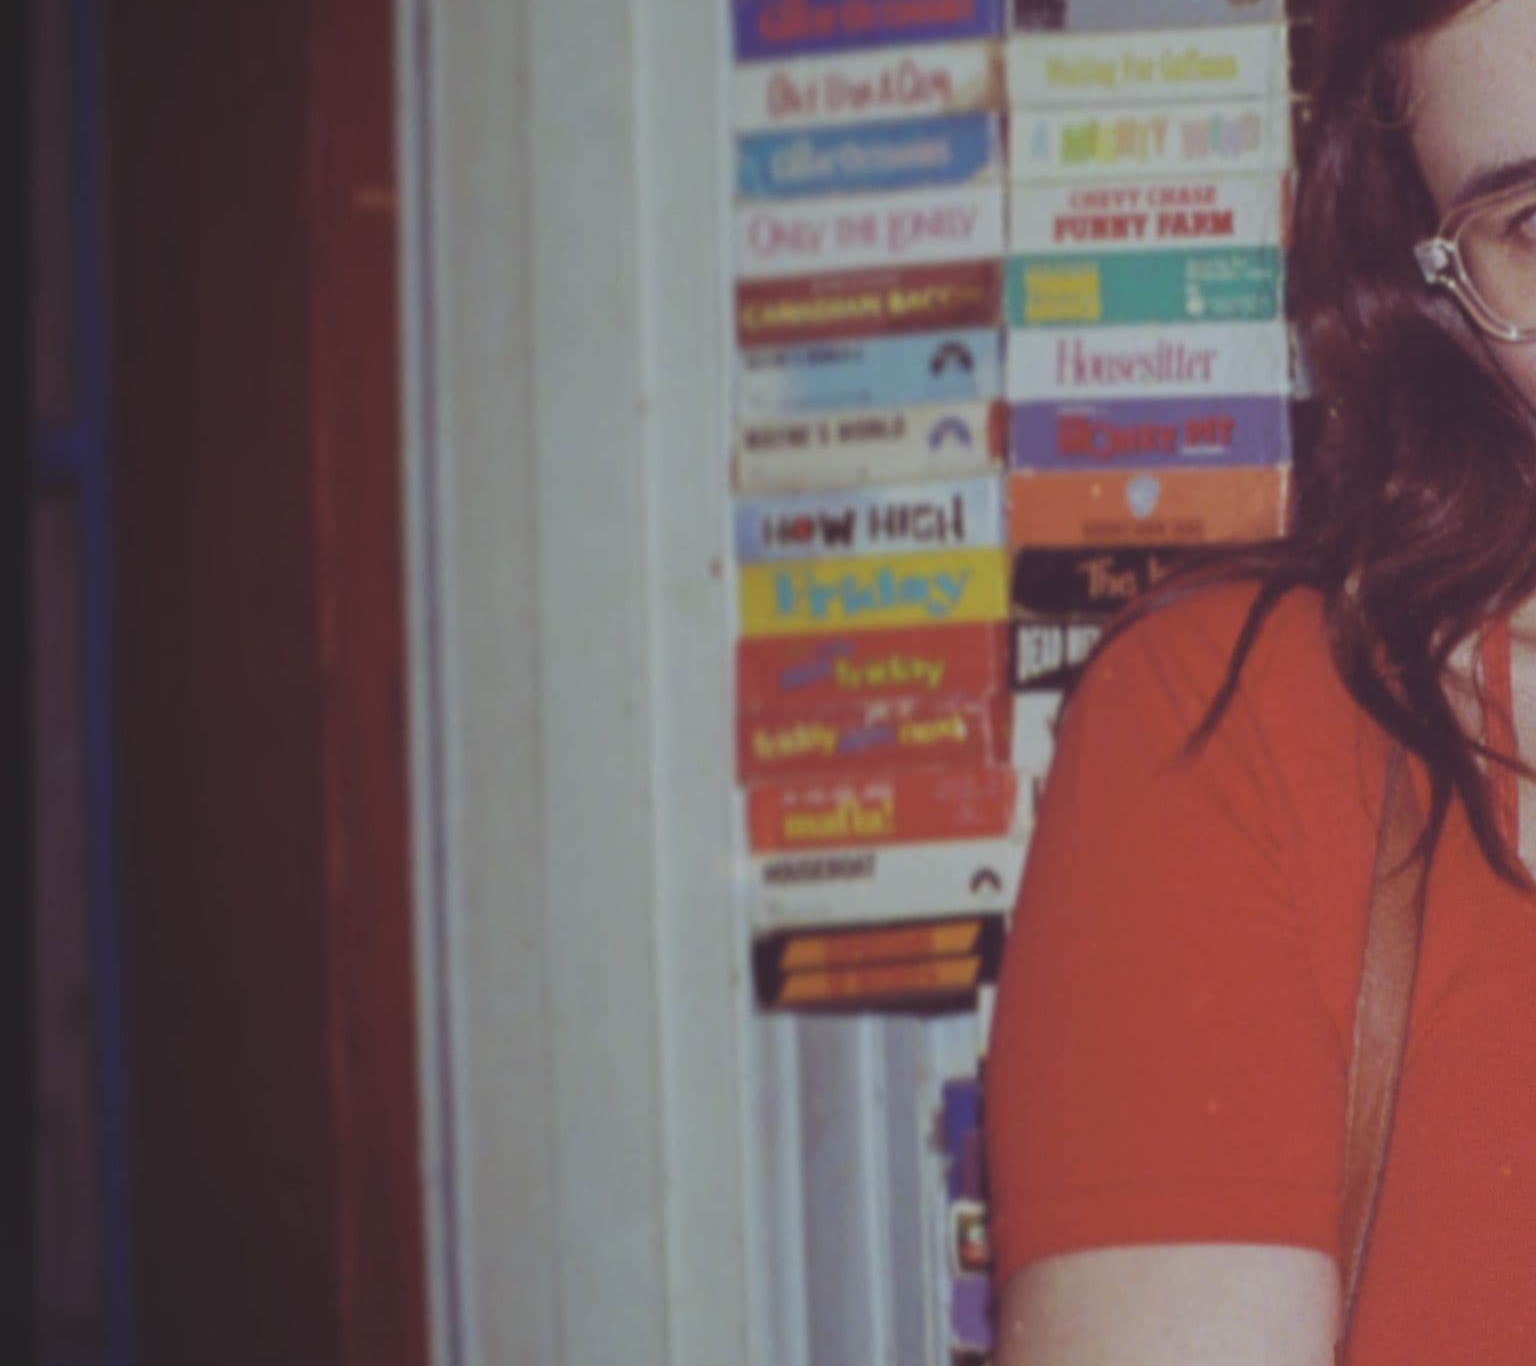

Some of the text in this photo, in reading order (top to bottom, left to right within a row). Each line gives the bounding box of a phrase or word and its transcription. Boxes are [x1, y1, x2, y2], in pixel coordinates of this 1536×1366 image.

[1147, 184, 1218, 206] CHASE
[1157, 208, 1235, 238] FARM
[761, 491, 965, 548] HOW HIGH
[773, 565, 971, 618] Friday
